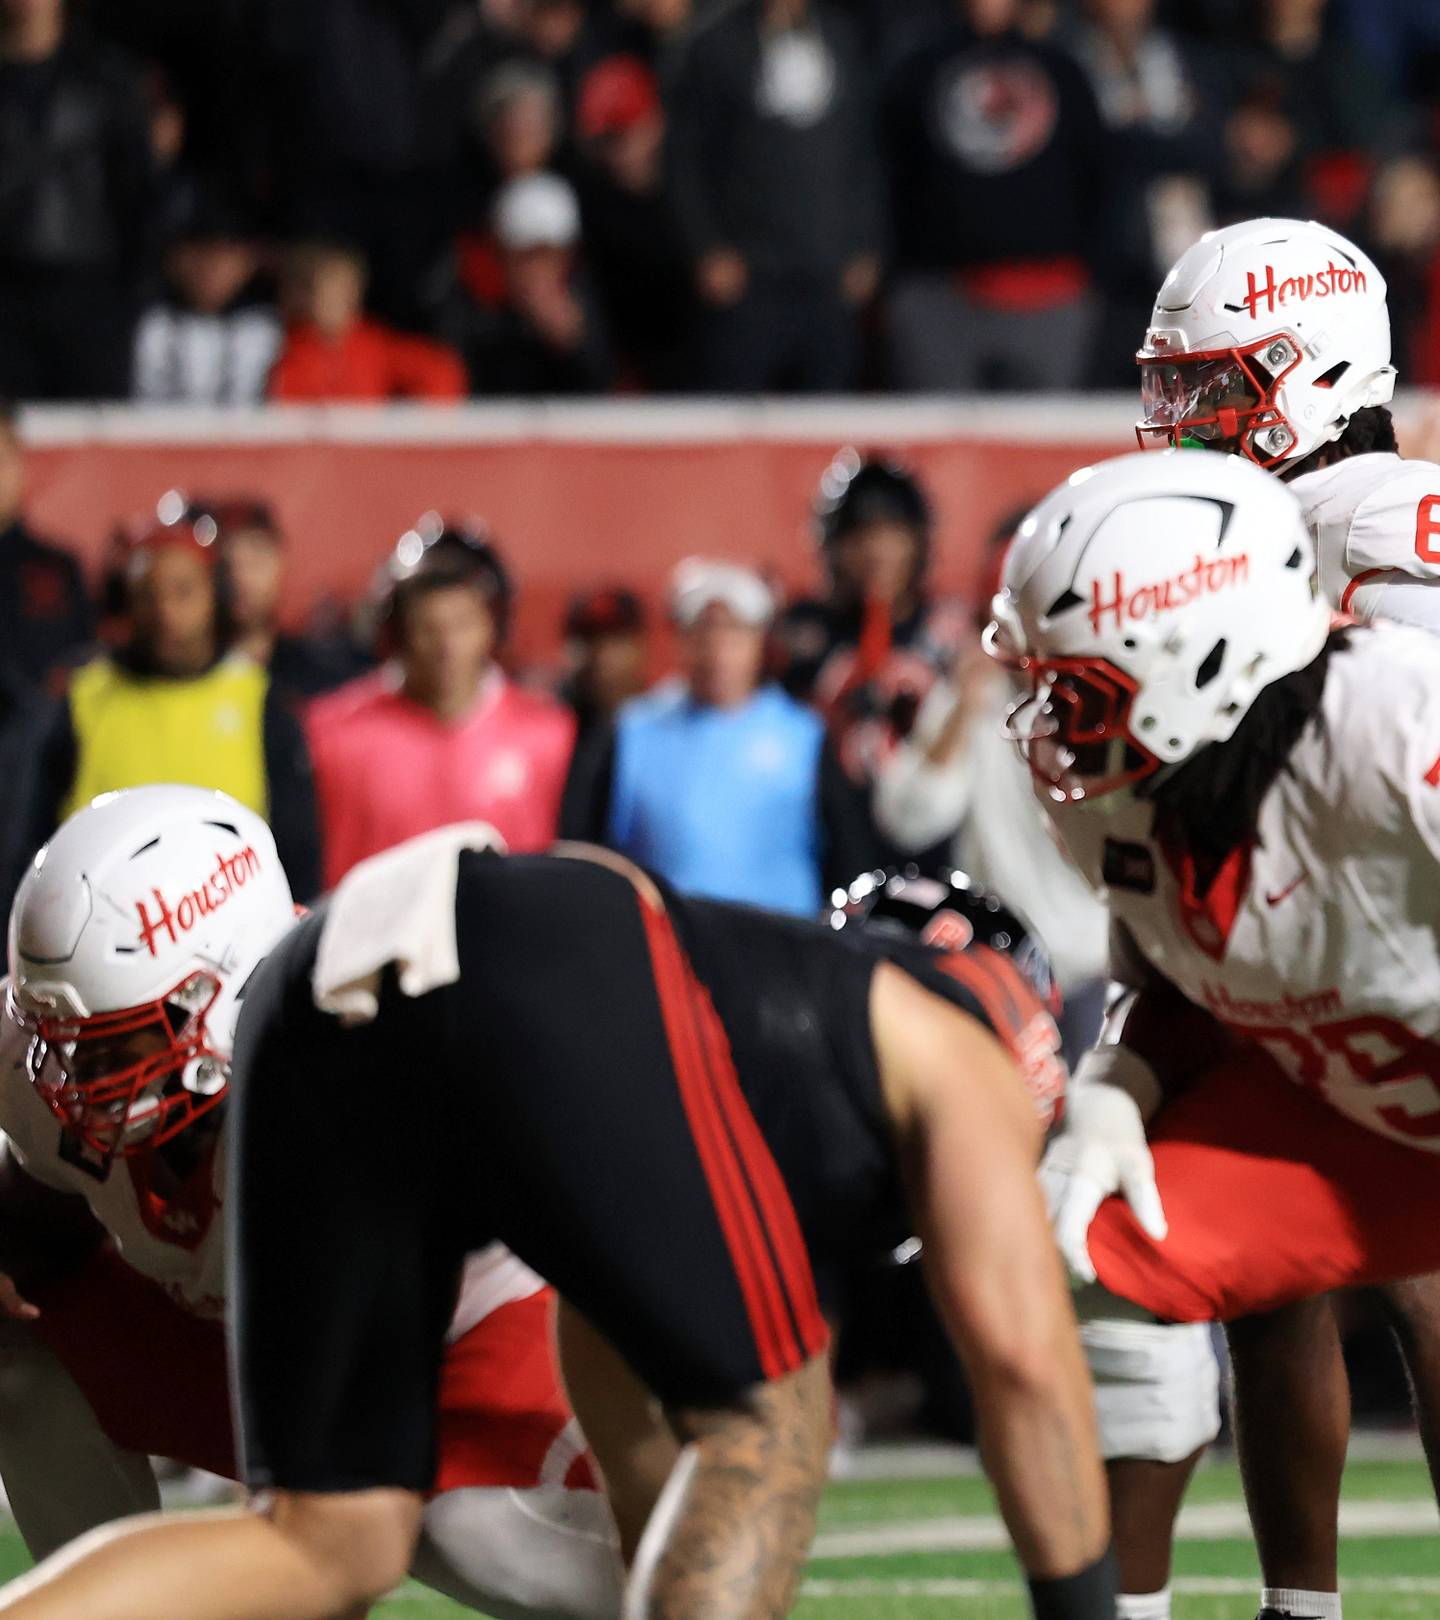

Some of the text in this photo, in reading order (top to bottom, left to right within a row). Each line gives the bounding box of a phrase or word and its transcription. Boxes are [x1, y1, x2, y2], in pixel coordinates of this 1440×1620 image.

[1243, 260, 1367, 320] Houston
[1087, 553, 1249, 636] Houston
[135, 845, 261, 957] Houston
